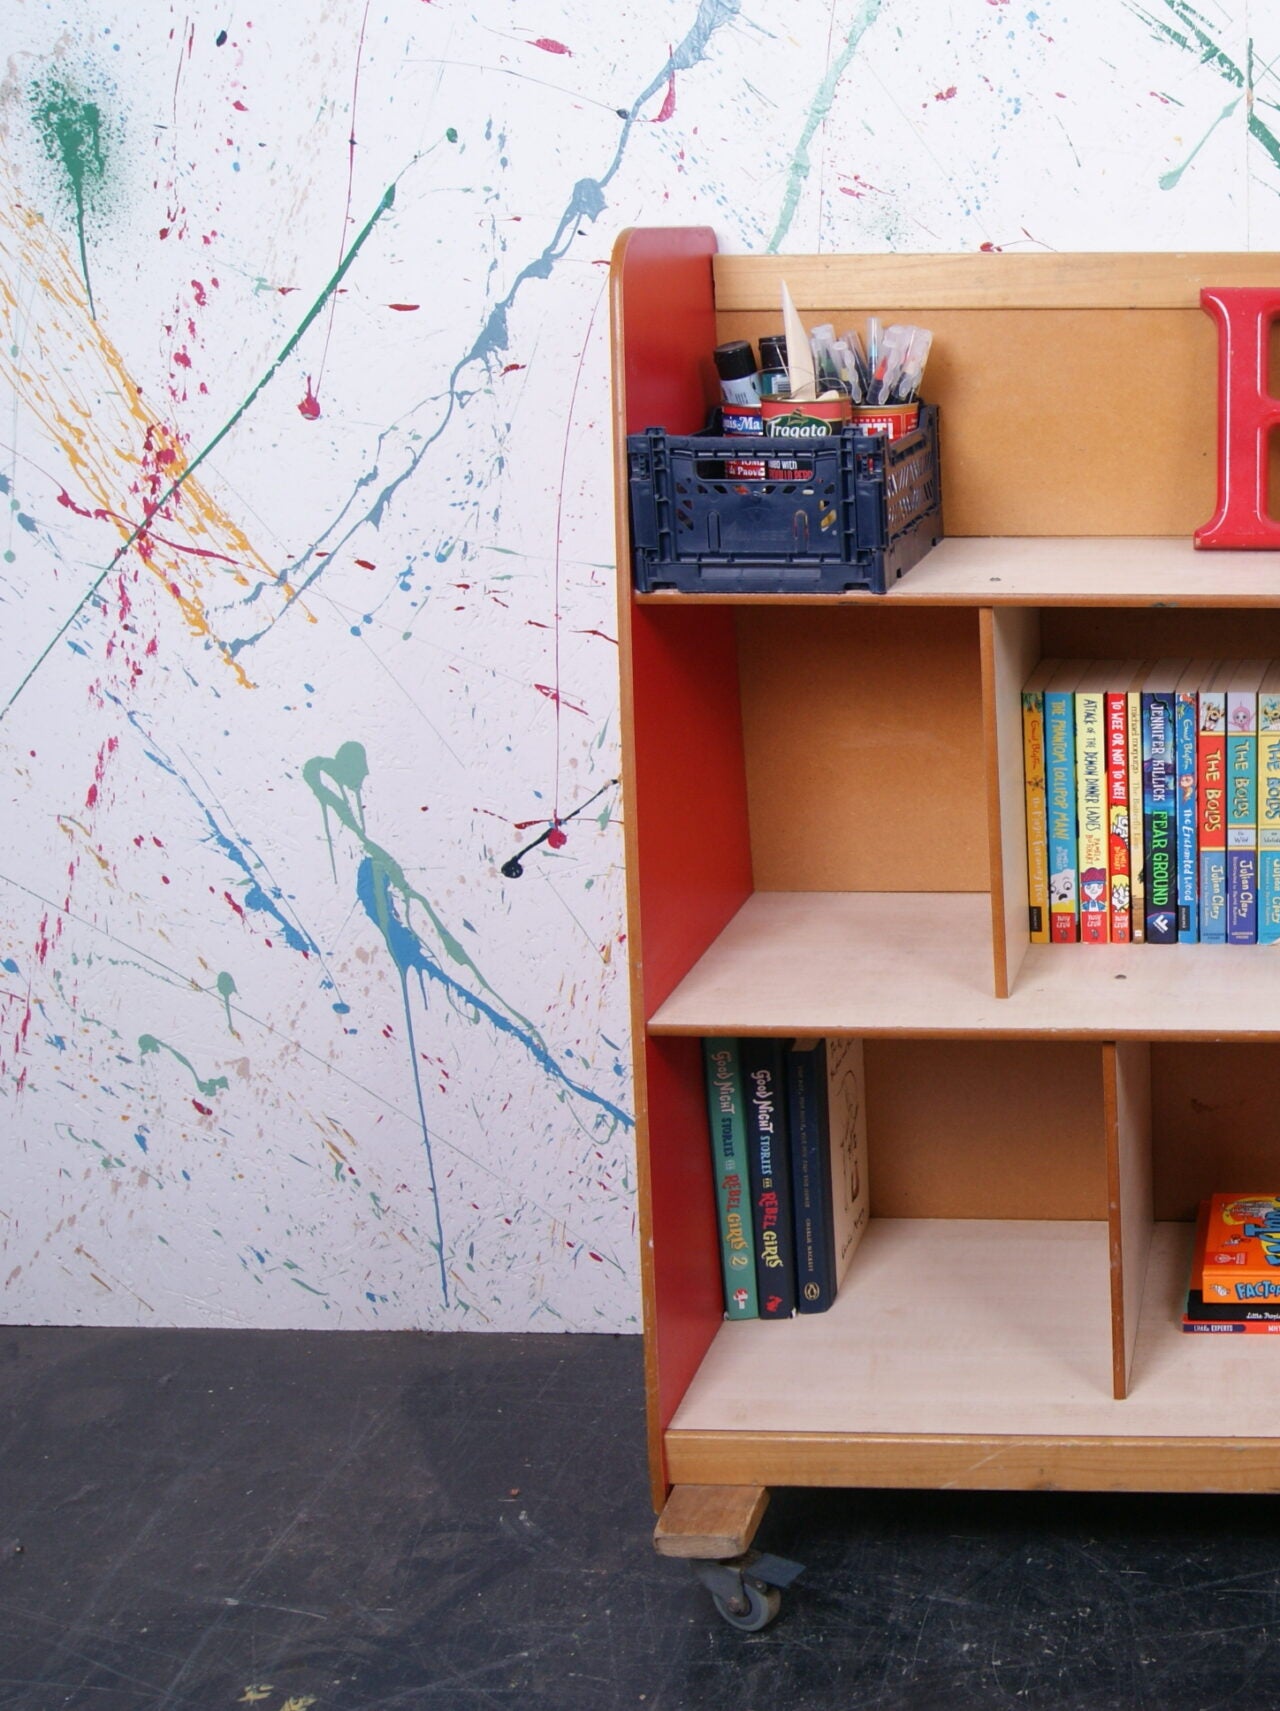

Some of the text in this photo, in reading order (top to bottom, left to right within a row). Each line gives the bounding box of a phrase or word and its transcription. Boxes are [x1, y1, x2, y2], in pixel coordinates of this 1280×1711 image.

[1084, 699, 1098, 725] ATTACK
[1111, 712, 1125, 731] WEE
[1131, 707, 1140, 736] michael
[1086, 737, 1096, 748] THE
[1112, 733, 1125, 746] OR
[1181, 719, 1193, 742] Enid
[1084, 751, 1099, 777] DEMON
[1112, 748, 1125, 767] NOT
[1150, 703, 1166, 802] JENNIFER KILLICK
[1051, 700, 1070, 840] THE PHANTOM LOLLIPOP MAN!
[1232, 739, 1251, 819] THE BOLDS
[1084, 778, 1101, 804] DINNER
[1113, 781, 1127, 800] WEE!
[1203, 749, 1223, 833] THE BOLDS
[1085, 807, 1102, 832] LADIES
[1152, 810, 1168, 849] FEAR
[1182, 808, 1195, 901] The Enchanted Wood
[1152, 852, 1169, 906] GROUND
[1211, 864, 1225, 894] Julian
[1238, 859, 1255, 891] Julian
[1210, 894, 1225, 920] Clary
[1237, 891, 1253, 919] Clary
[711, 1050, 735, 1080] GooD
[713, 1081, 736, 1115] NiGHT
[750, 1070, 774, 1099] GooD
[752, 1099, 775, 1134] NiGHT
[721, 1117, 735, 1157] STORIES
[760, 1135, 773, 1175] STORIES
[722, 1173, 742, 1212] REBEL
[758, 1191, 779, 1230] REBEL
[725, 1213, 749, 1250] GiRLS
[761, 1230, 784, 1268] GiRLS
